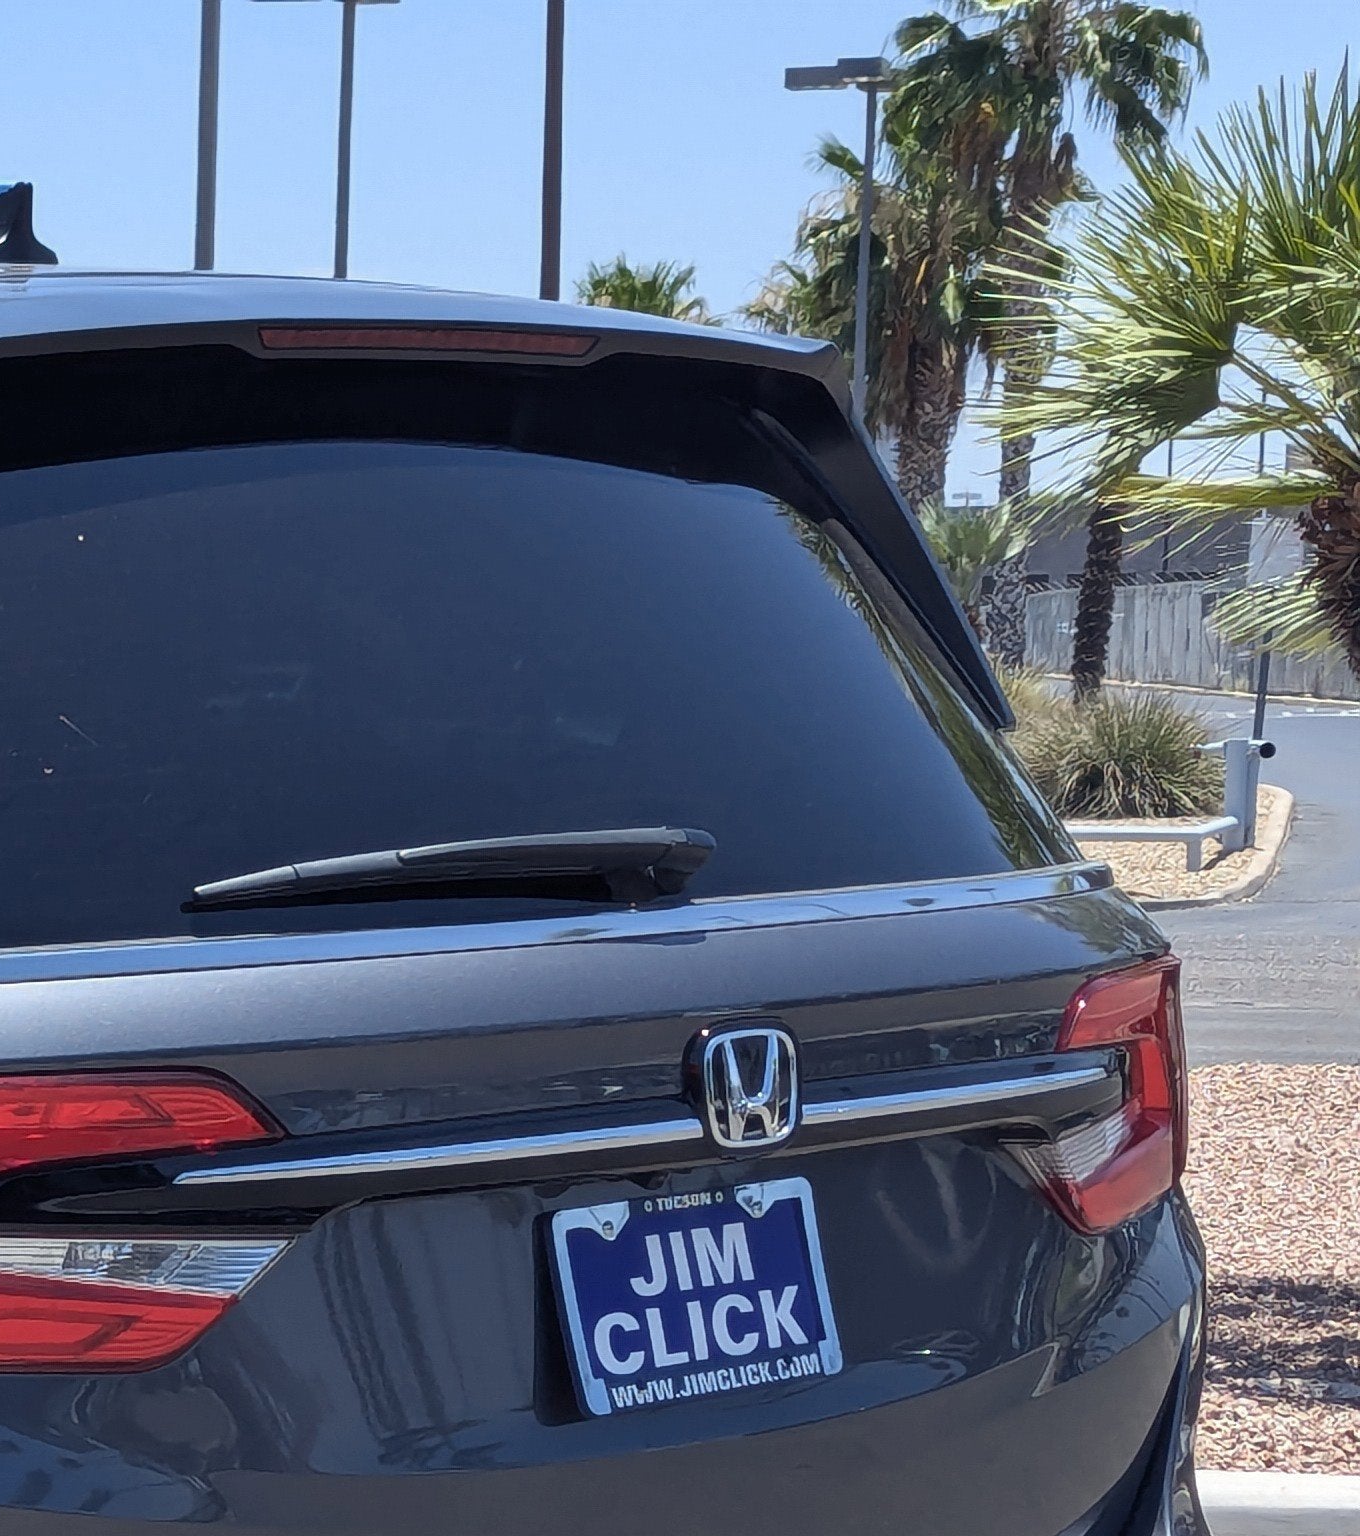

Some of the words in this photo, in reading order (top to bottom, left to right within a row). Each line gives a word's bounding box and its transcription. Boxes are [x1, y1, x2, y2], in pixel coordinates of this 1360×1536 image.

[629, 1222, 755, 1297] JIM
[593, 1285, 809, 1375] CLICK
[611, 1353, 821, 1408] WWW.JIMCLICK.COM
